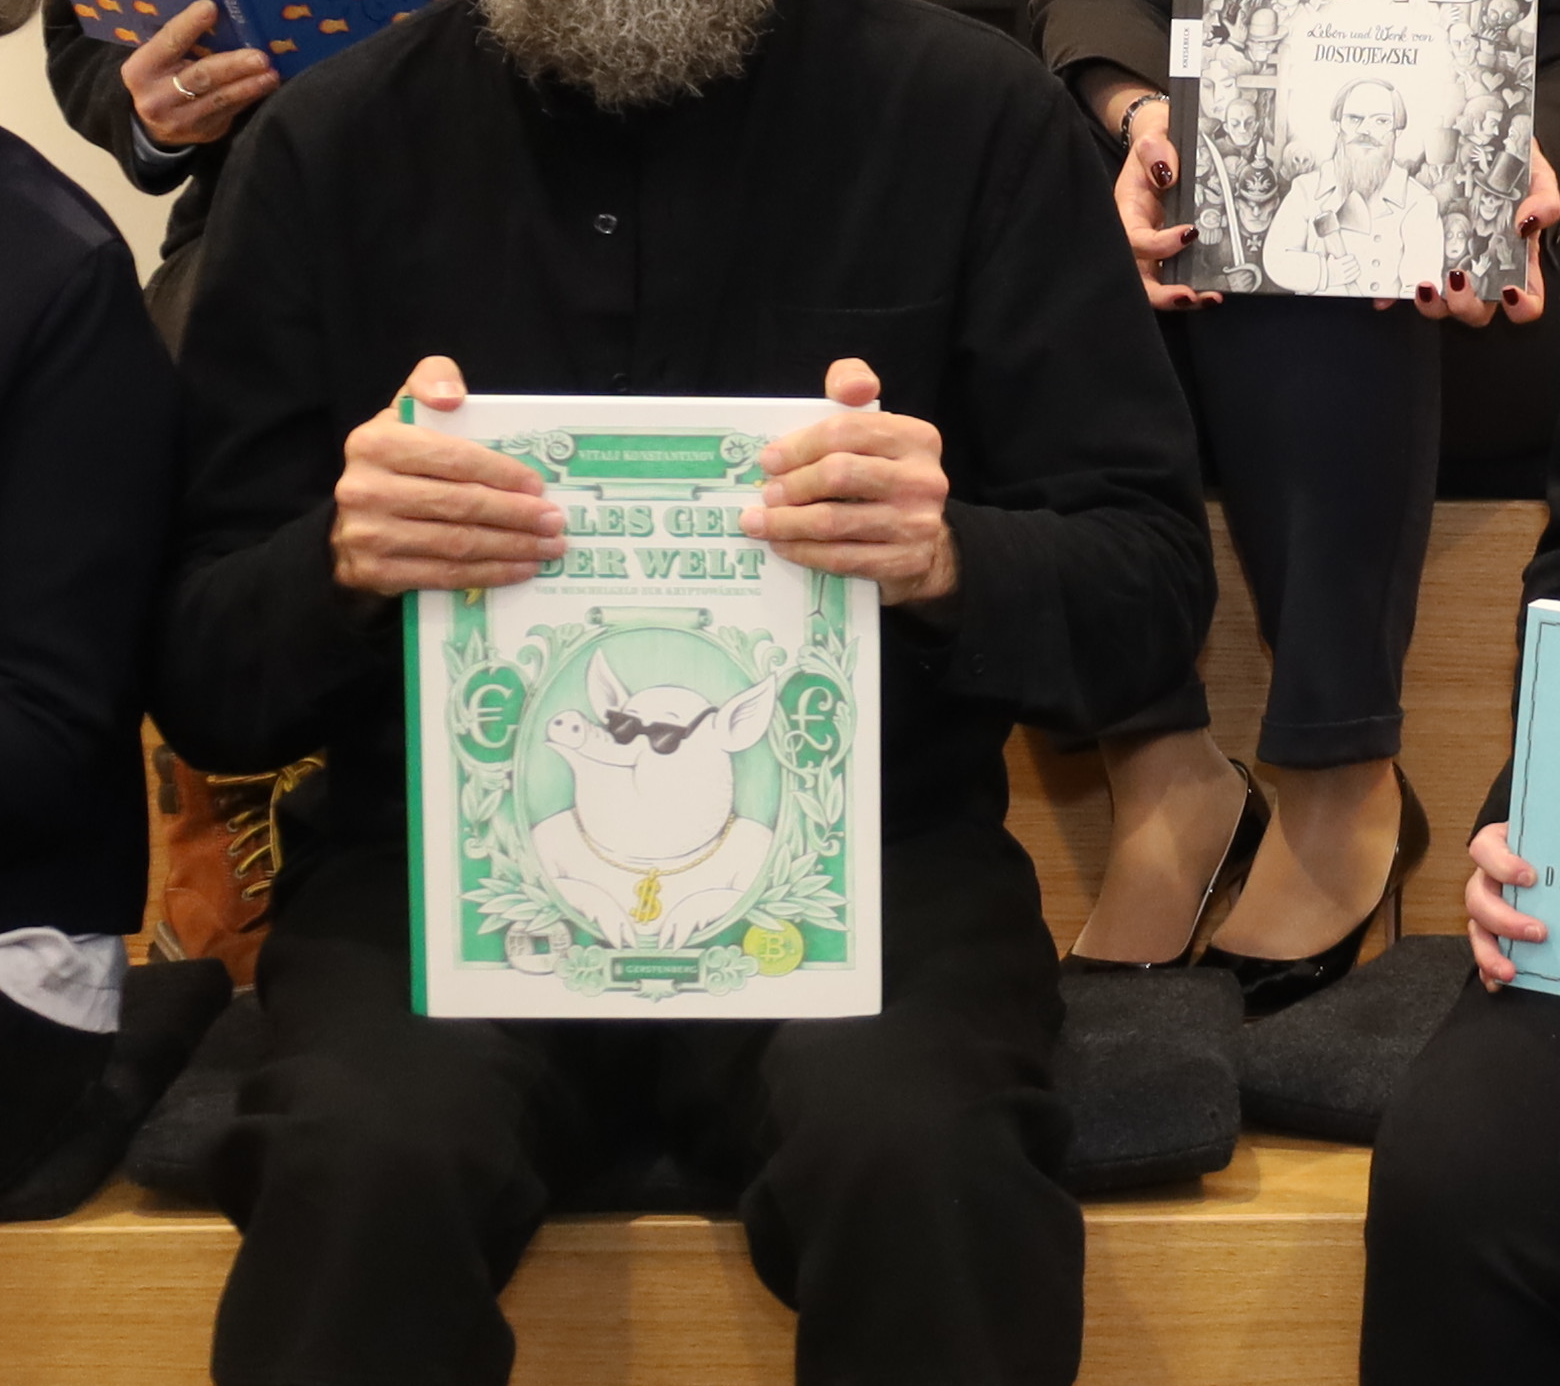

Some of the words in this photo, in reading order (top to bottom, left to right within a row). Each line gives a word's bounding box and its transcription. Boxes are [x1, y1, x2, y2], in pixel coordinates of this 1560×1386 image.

[1307, 23, 1347, 39] Leben
[1350, 27, 1371, 39] und
[1375, 25, 1407, 41] Werk
[1412, 33, 1433, 42] von
[1314, 44, 1419, 65] DOSTOJEWSKI
[664, 505, 746, 537] GEL
[634, 548, 766, 580] WELT
[625, 964, 699, 975] GERSTENBERG
